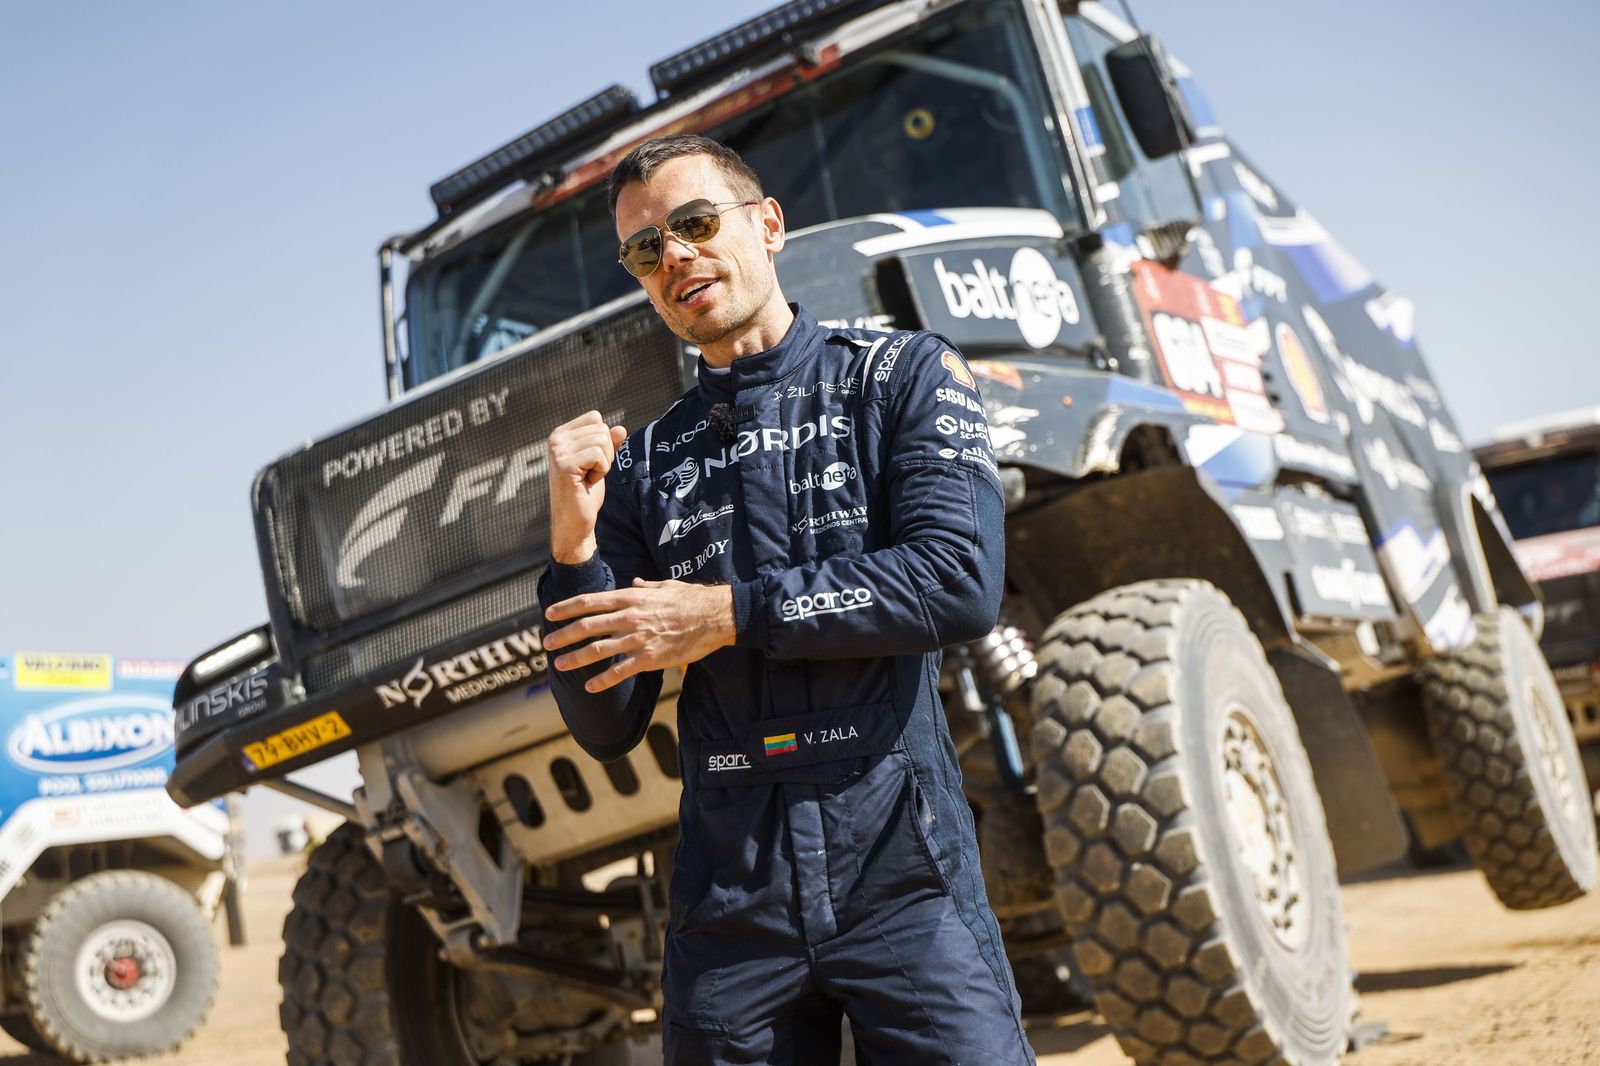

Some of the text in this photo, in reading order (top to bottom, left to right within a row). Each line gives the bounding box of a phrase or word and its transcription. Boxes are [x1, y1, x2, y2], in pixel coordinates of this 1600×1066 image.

[322, 387, 509, 487] POWERED BY
[656, 419, 710, 453] SKOD
[959, 418, 987, 434] IVE
[670, 539, 729, 580] DE ROOY
[782, 588, 873, 621] sparco
[374, 624, 543, 709] NORTHW
[446, 661, 531, 703] MEDICINOS
[803, 725, 859, 745] V. ZALA
[708, 753, 752, 771] sparc
